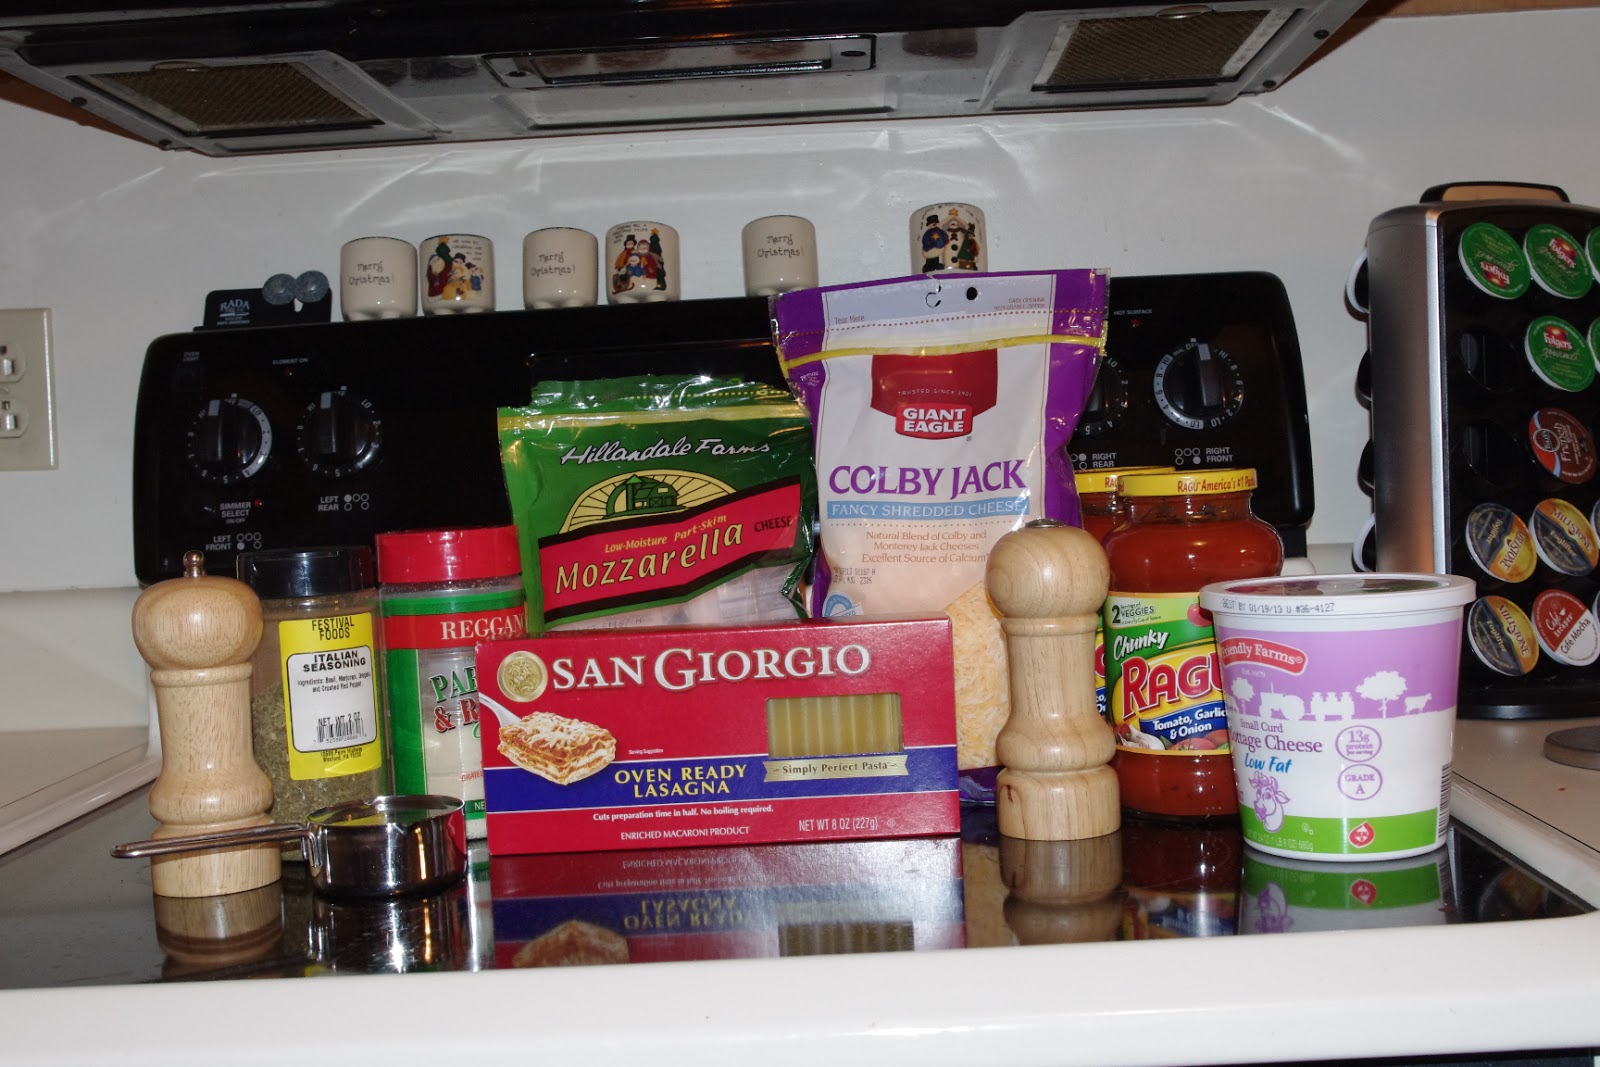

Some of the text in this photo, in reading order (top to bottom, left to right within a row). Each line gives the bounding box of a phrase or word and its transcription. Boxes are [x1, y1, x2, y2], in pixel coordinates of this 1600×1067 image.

[1548, 238, 1576, 268] Folgers
[1480, 261, 1510, 285] Folgers
[1543, 331, 1573, 350] Folgers
[903, 407, 967, 420] GIANT
[904, 421, 965, 433] EAGLE
[561, 435, 770, 465] Hillandale Farms
[1092, 452, 1117, 460] RIGHT
[1205, 447, 1230, 455] RIGHT
[1092, 460, 1114, 468] REAR
[1206, 455, 1233, 463] FRONT
[829, 459, 1028, 500] COLBY JACK
[1202, 476, 1236, 491] America's
[220, 501, 252, 511] SIMMER
[320, 496, 339, 504] LEFT
[221, 509, 250, 518] SELECT
[832, 500, 1024, 518] FANCY SHREDDED CHEESE
[754, 515, 792, 533] CHEESE
[1551, 508, 1593, 551] MILLSTONE
[213, 535, 231, 543] LEFT
[605, 514, 727, 553] Low-Moisture Part-Skim
[866, 530, 987, 544] Natural Blend of Colby and
[205, 542, 231, 551] FRONT
[873, 541, 979, 552] Monterey Jack Cheeses
[1499, 530, 1525, 571] MILLSTONE
[555, 522, 744, 595] Mozzarella
[862, 553, 902, 563] Excellent
[904, 553, 938, 563] Source
[938, 553, 949, 563] of
[1112, 604, 1121, 624] 2
[1121, 606, 1155, 618] VEGGIES
[311, 615, 355, 632] FESTIVAL
[1498, 602, 1530, 656] MILLSTONE
[319, 627, 351, 641] FOODS
[1560, 618, 1591, 654] Café Mocha
[1113, 629, 1170, 662] Chunky
[314, 650, 358, 663] ITALIAN
[1254, 643, 1296, 665] Farms
[303, 657, 366, 673] SEASONING
[552, 644, 871, 690] SAN GIORGIO
[434, 706, 456, 733] &
[1153, 715, 1193, 731] Tomato,
[1240, 719, 1284, 733] Small Curd
[1170, 722, 1212, 740] & Onion
[1348, 730, 1370, 744] 13g
[1265, 734, 1323, 752] Cheese
[1346, 743, 1373, 751] protein
[782, 761, 888, 775] Simply Perfect Pasta
[1245, 753, 1292, 773] Low Fat
[614, 764, 747, 784] OVEN READY
[1345, 774, 1375, 782] GRADE
[634, 781, 731, 798] LASAGNA
[1355, 784, 1365, 795] A
[593, 805, 774, 822] Cuts preparation time in half. No boiling required.
[799, 817, 878, 832] NET WT 8 OZ (227g)
[620, 826, 750, 840] ENRICHED MACARONI PRODUCT
